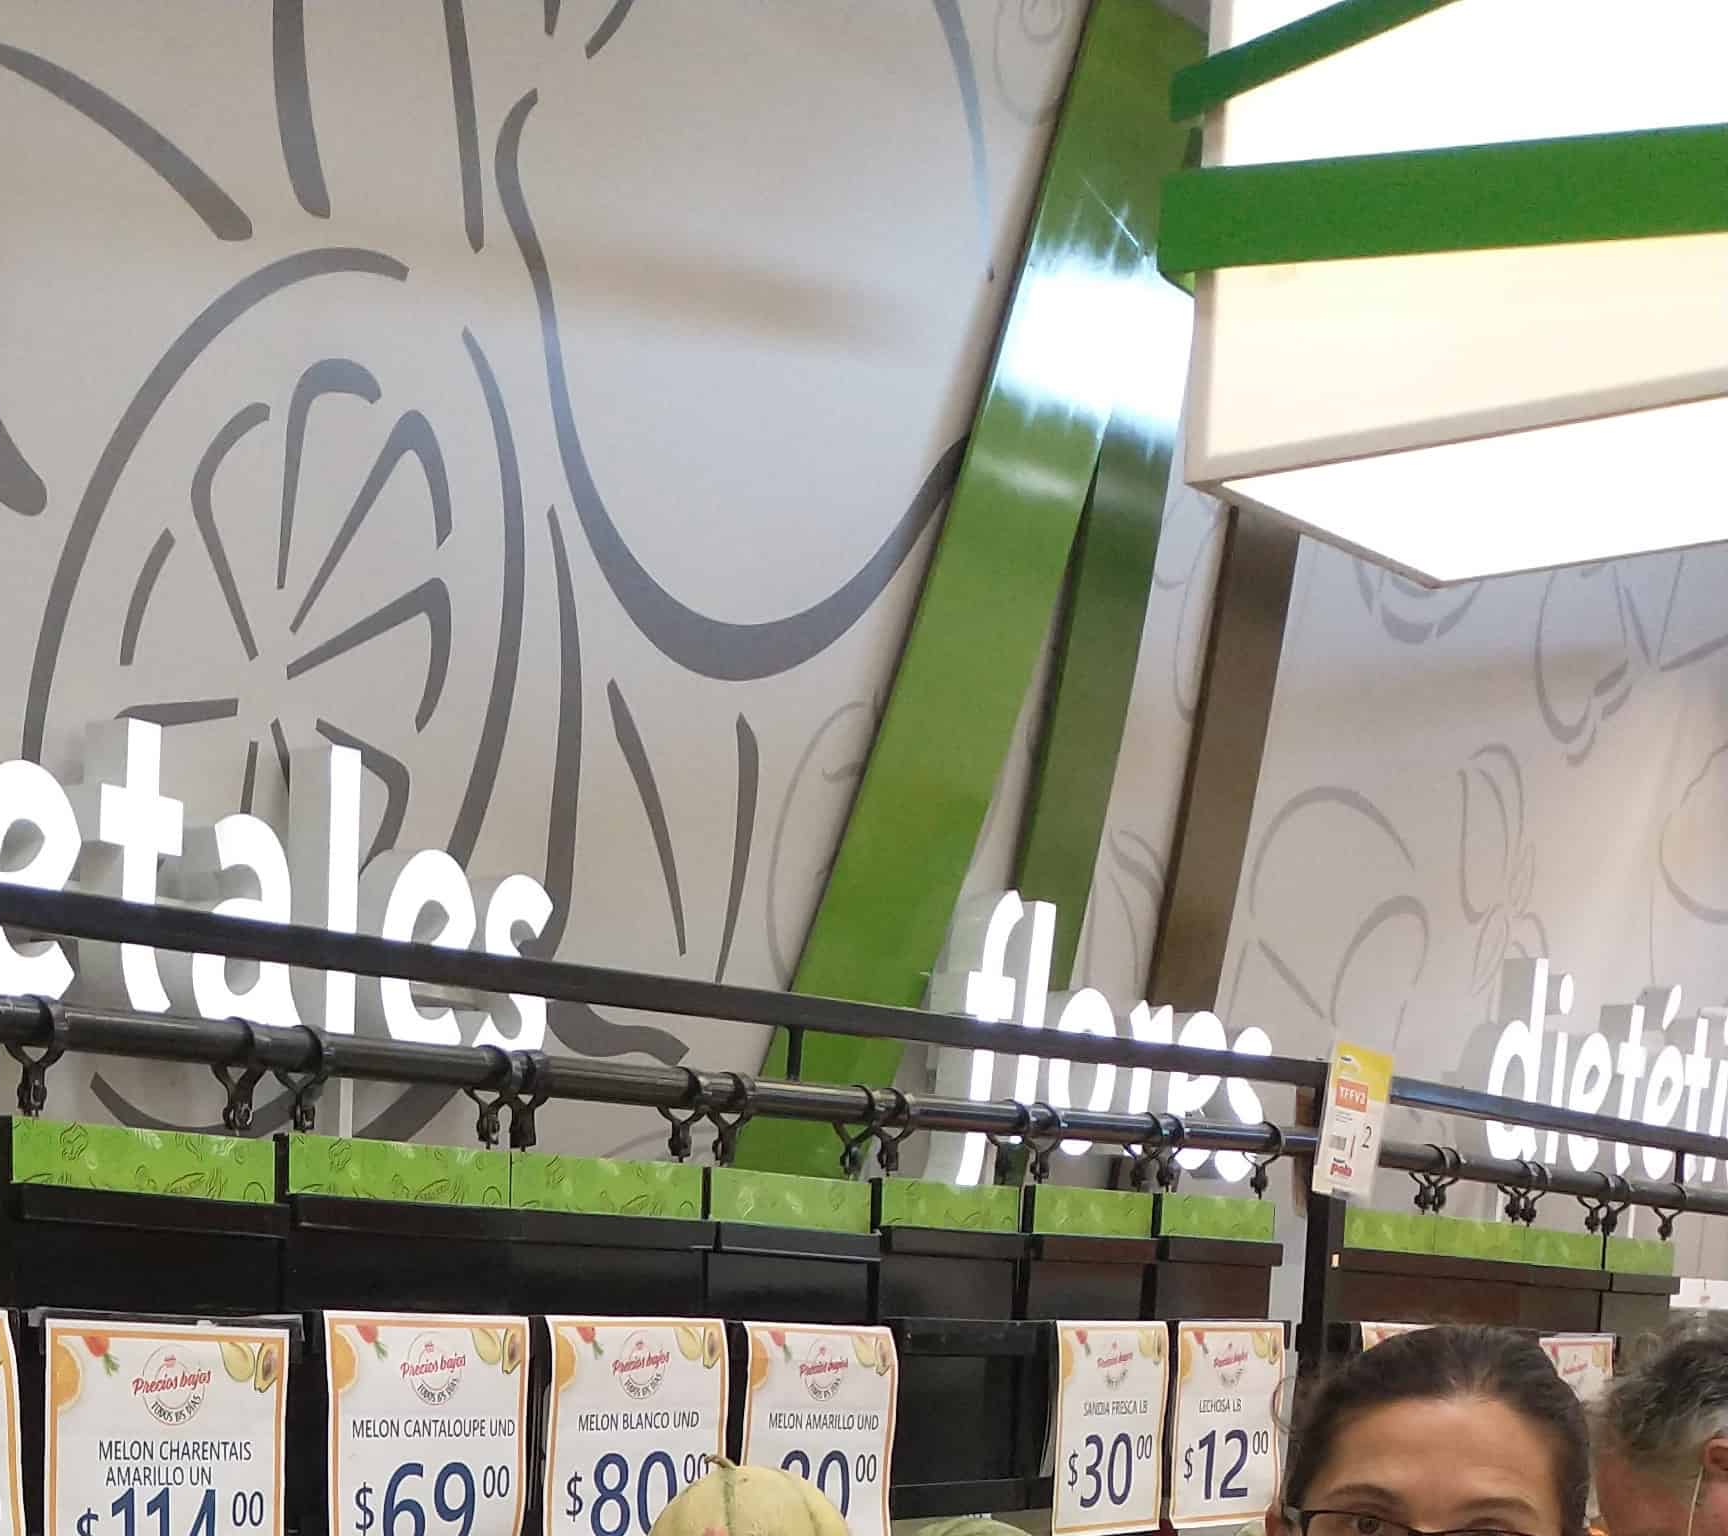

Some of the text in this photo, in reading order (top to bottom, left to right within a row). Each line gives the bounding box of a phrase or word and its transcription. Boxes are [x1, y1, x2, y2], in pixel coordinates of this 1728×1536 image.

[956, 889, 1271, 1185] flores
[352, 1418, 515, 1439] MELON CANTALOUPE UND
[578, 1411, 699, 1432] MELON BLANCO UND
[769, 1412, 879, 1431] MELON AMARILLO UND
[99, 1440, 252, 1462] MELON CHARENTAIS
[1183, 1429, 1269, 1500] $ 12 00
[105, 1466, 212, 1487] AMARILLO UN
[855, 1454, 877, 1483] 00
[1068, 1432, 1153, 1508] $ 30 00
[232, 1490, 264, 1528] 00
[355, 1481, 375, 1536] $
[483, 1465, 510, 1498] 00
[566, 1471, 584, 1522] $
